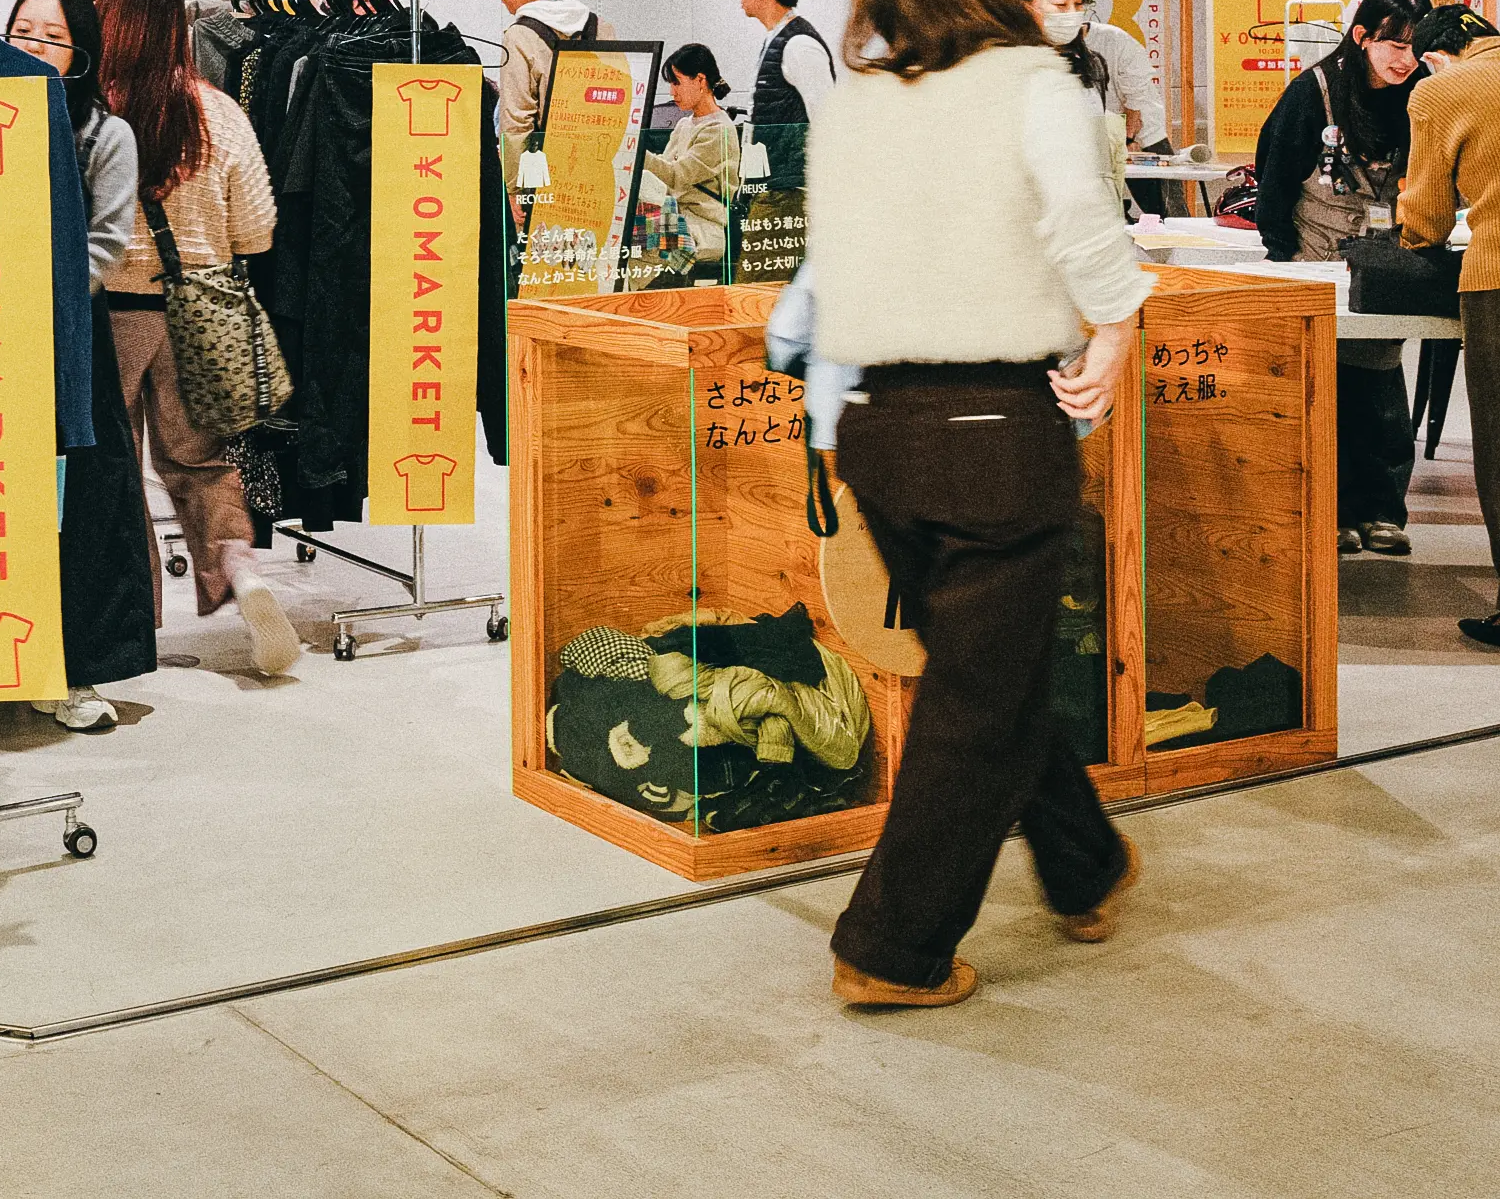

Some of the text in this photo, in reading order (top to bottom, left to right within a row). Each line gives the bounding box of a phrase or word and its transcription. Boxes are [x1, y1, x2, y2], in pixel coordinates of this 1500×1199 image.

[515, 192, 556, 205] RECYCLE
[742, 183, 769, 194] REUSE
[516, 227, 591, 244] たくさん着て、
[517, 264, 676, 286] なんとかゴミじゃないカタチへ
[1152, 338, 1229, 368] めっちゃ
[706, 377, 805, 410] さよなら
[1153, 374, 1227, 405] ええ服。
